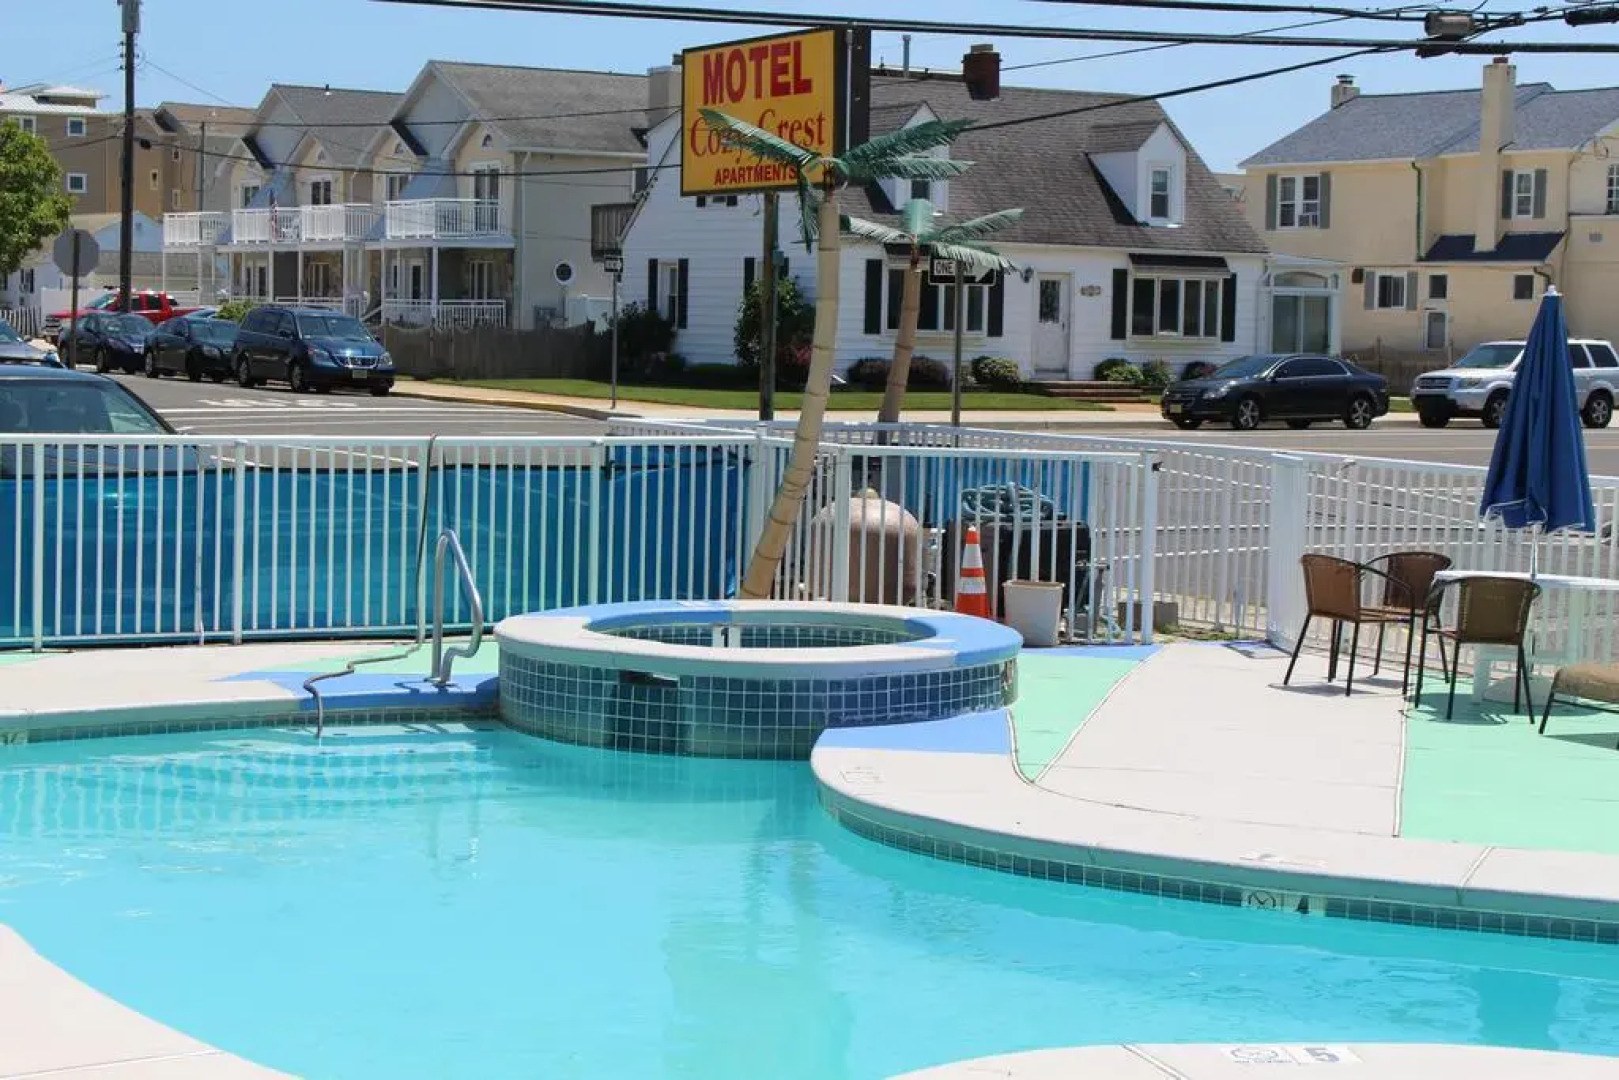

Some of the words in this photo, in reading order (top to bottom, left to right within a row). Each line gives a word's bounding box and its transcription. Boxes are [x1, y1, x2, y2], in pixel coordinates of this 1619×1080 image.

[703, 40, 812, 105] MOTEL
[714, 164, 797, 185] APARTMENTS
[935, 260, 954, 275] ONE
[721, 627, 730, 648] 1
[1303, 1047, 1340, 1062] 5
